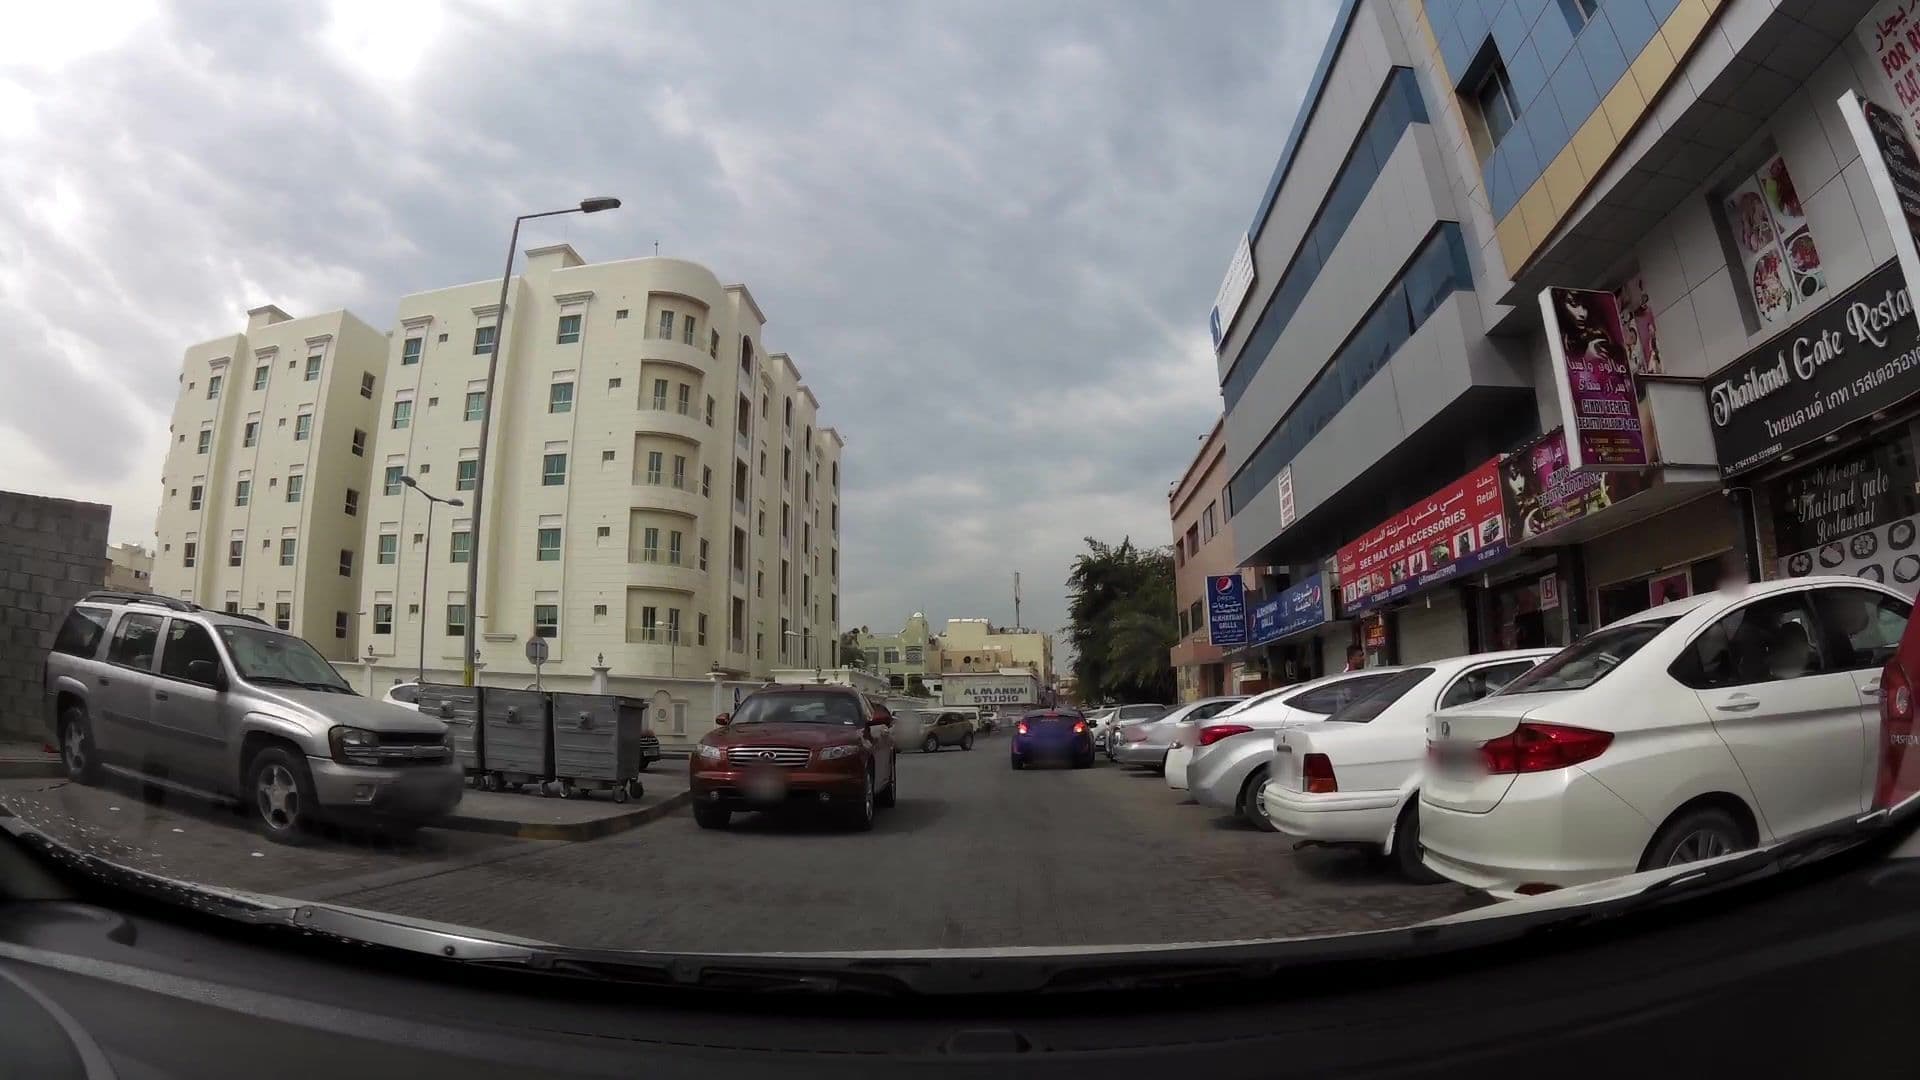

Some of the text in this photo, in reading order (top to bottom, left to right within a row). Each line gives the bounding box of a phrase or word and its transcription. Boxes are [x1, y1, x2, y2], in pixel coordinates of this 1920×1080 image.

[1881, 42, 1911, 79] FOR
[1711, 349, 1792, 427] Thailand
[1793, 329, 1844, 381] Gate
[1476, 487, 1498, 506] Retail
[1798, 467, 1888, 523] Thailand gate
[1360, 558, 1372, 570] SEE
[1373, 549, 1389, 563] MAX
[1390, 539, 1406, 554] CAR
[1406, 508, 1467, 547] ACCESSORIES
[1817, 501, 1875, 545] Restaurant
[963, 688, 979, 696] AL
[974, 695, 1019, 703] STUDIO
